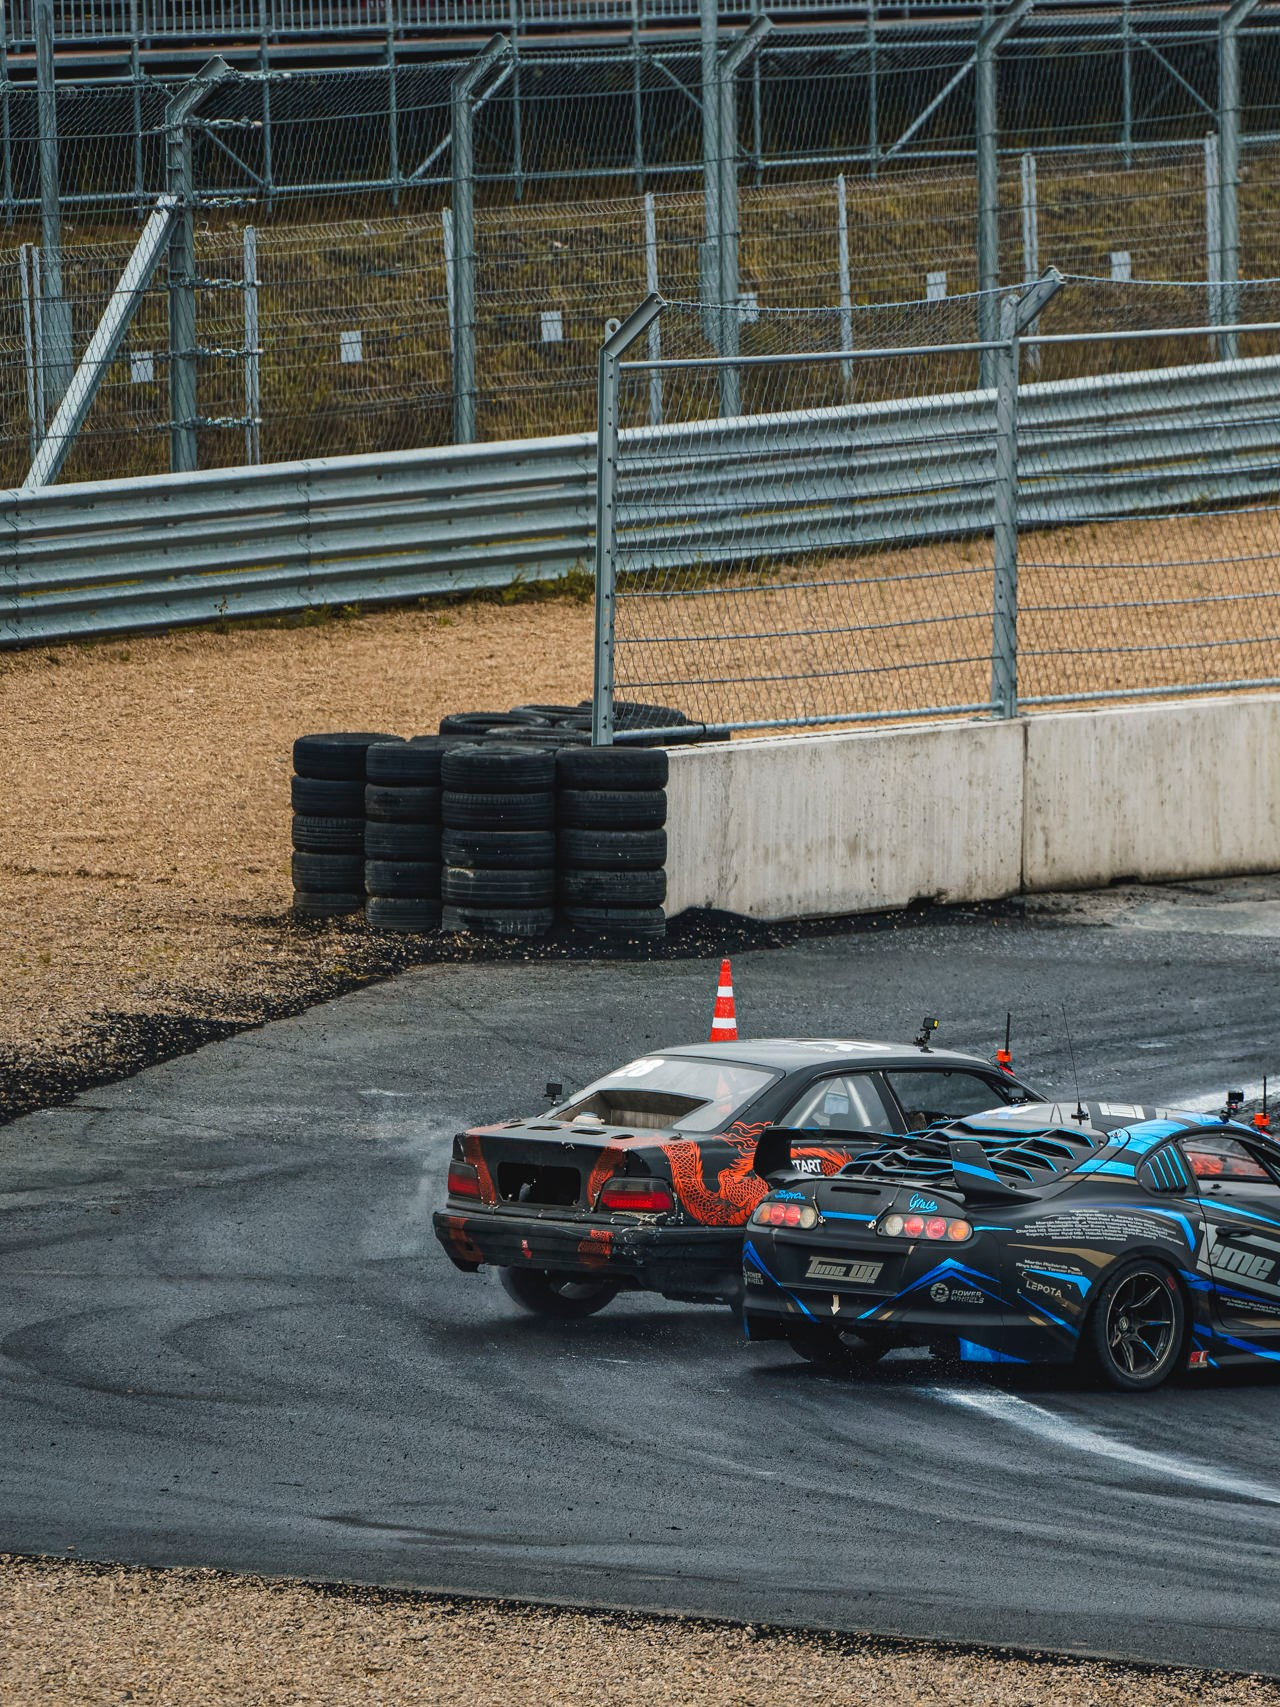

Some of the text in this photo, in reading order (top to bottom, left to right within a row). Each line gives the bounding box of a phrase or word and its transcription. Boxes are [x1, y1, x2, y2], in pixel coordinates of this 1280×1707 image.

[791, 1159, 822, 1173] TART
[952, 1289, 982, 1298] POWER
[1026, 1280, 1062, 1298] LEPOTA
